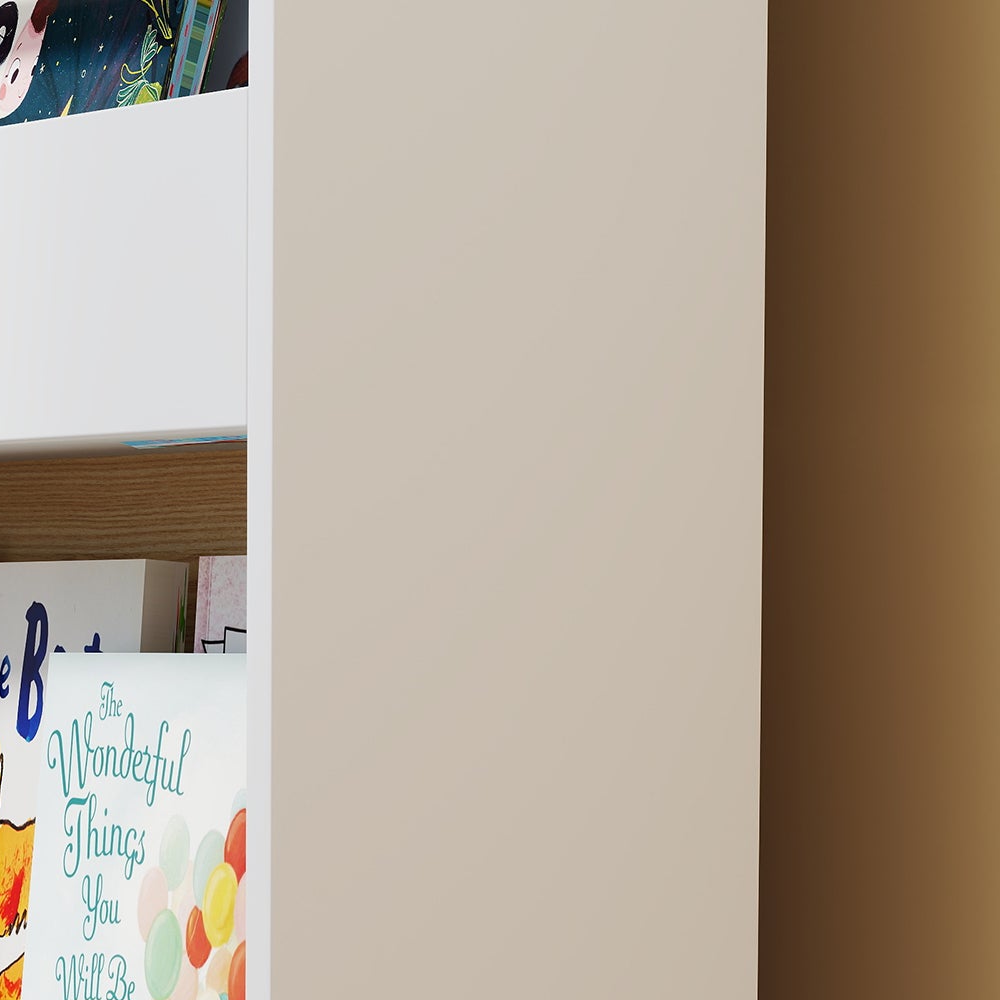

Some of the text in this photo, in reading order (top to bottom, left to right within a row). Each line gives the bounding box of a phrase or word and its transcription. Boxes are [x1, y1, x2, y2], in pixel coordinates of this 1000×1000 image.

[99, 681, 123, 721] The
[47, 712, 191, 806] Wonderful
[63, 791, 146, 880] Things
[81, 873, 121, 941] You
